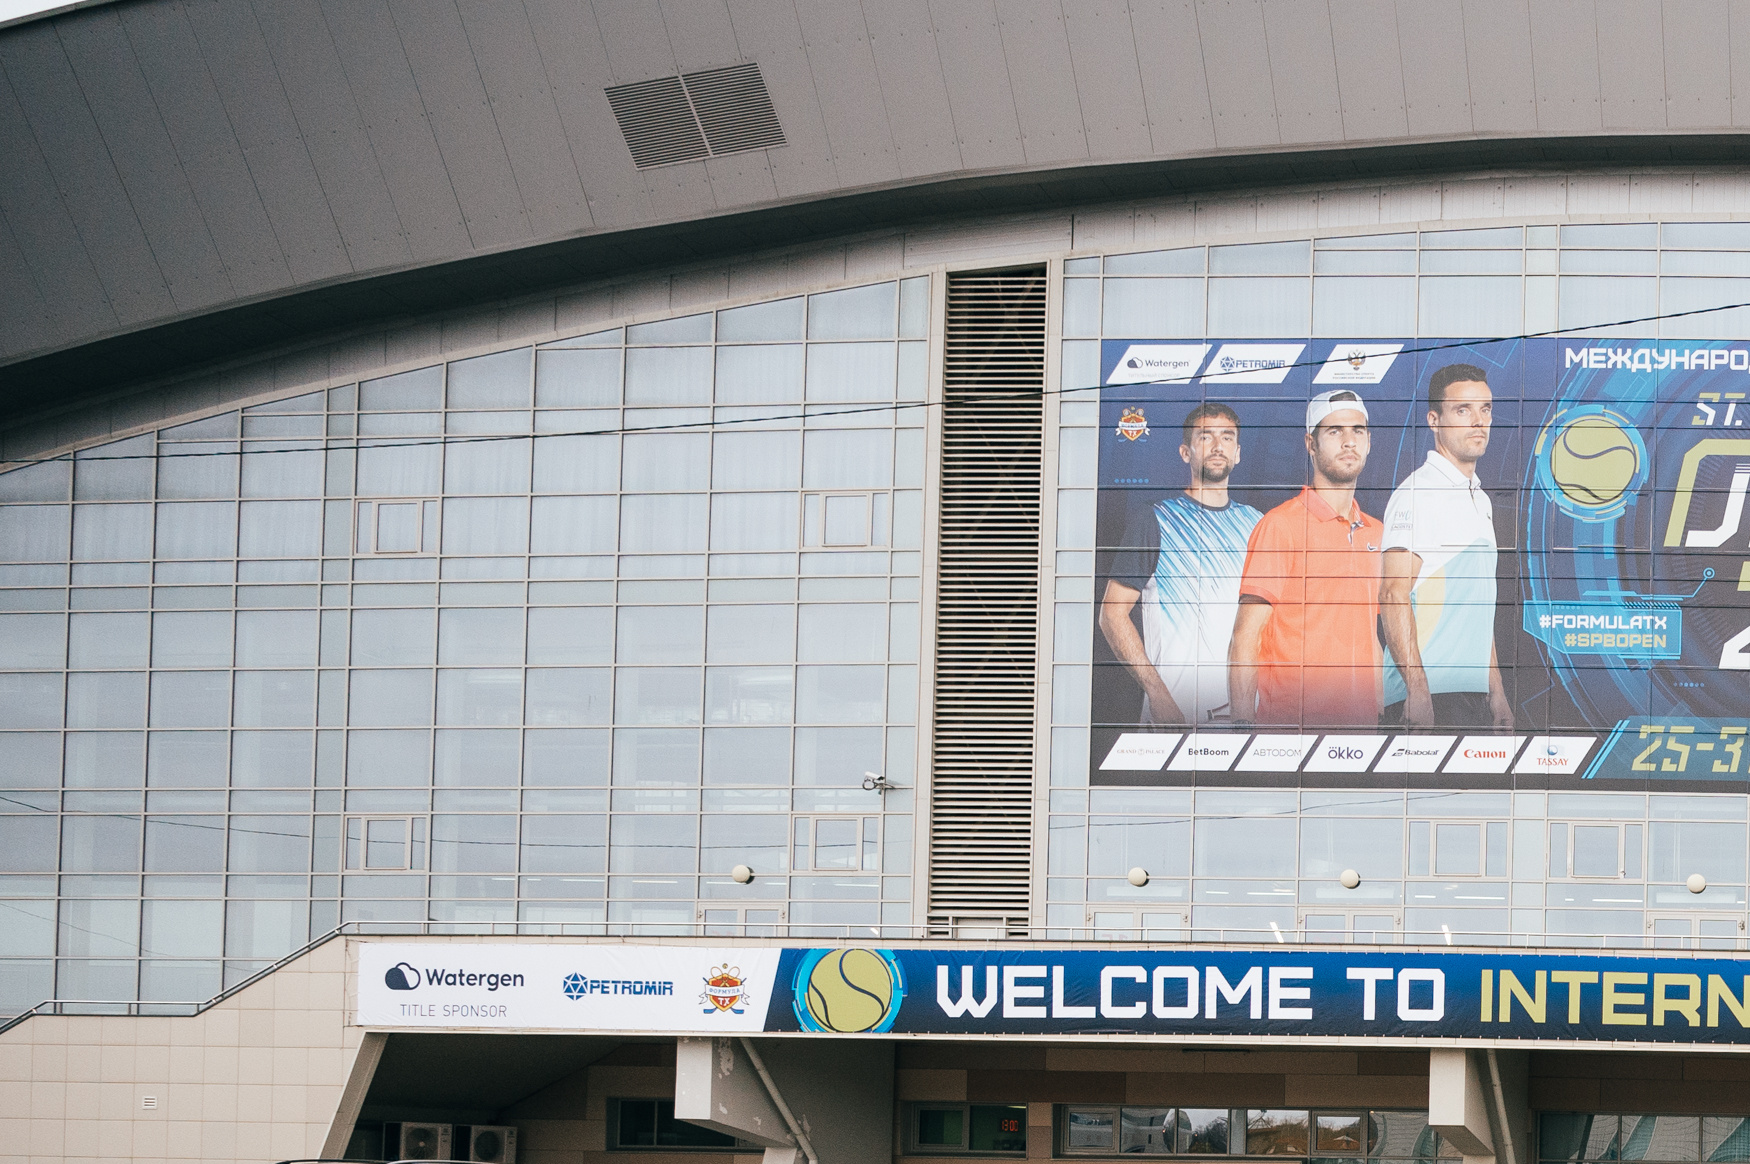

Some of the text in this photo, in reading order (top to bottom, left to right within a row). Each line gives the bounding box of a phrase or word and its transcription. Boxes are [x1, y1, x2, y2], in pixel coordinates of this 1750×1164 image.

[1145, 359, 1189, 369] Watergen
[1692, 392, 1742, 427] ST.
[1539, 614, 1667, 630] #FORMULATX
[1564, 633, 1667, 648] #SPBOPEN
[1188, 748, 1229, 756] BetBoom
[1463, 748, 1506, 759] Canon
[1537, 757, 1569, 766] TASSAY
[425, 968, 524, 991] Watergen
[709, 987, 741, 995] ФОРМУЛА
[936, 964, 1314, 1020] WELCOME
[1346, 967, 1446, 1022] TO
[400, 1004, 508, 1018] TITLE SPONSOR
